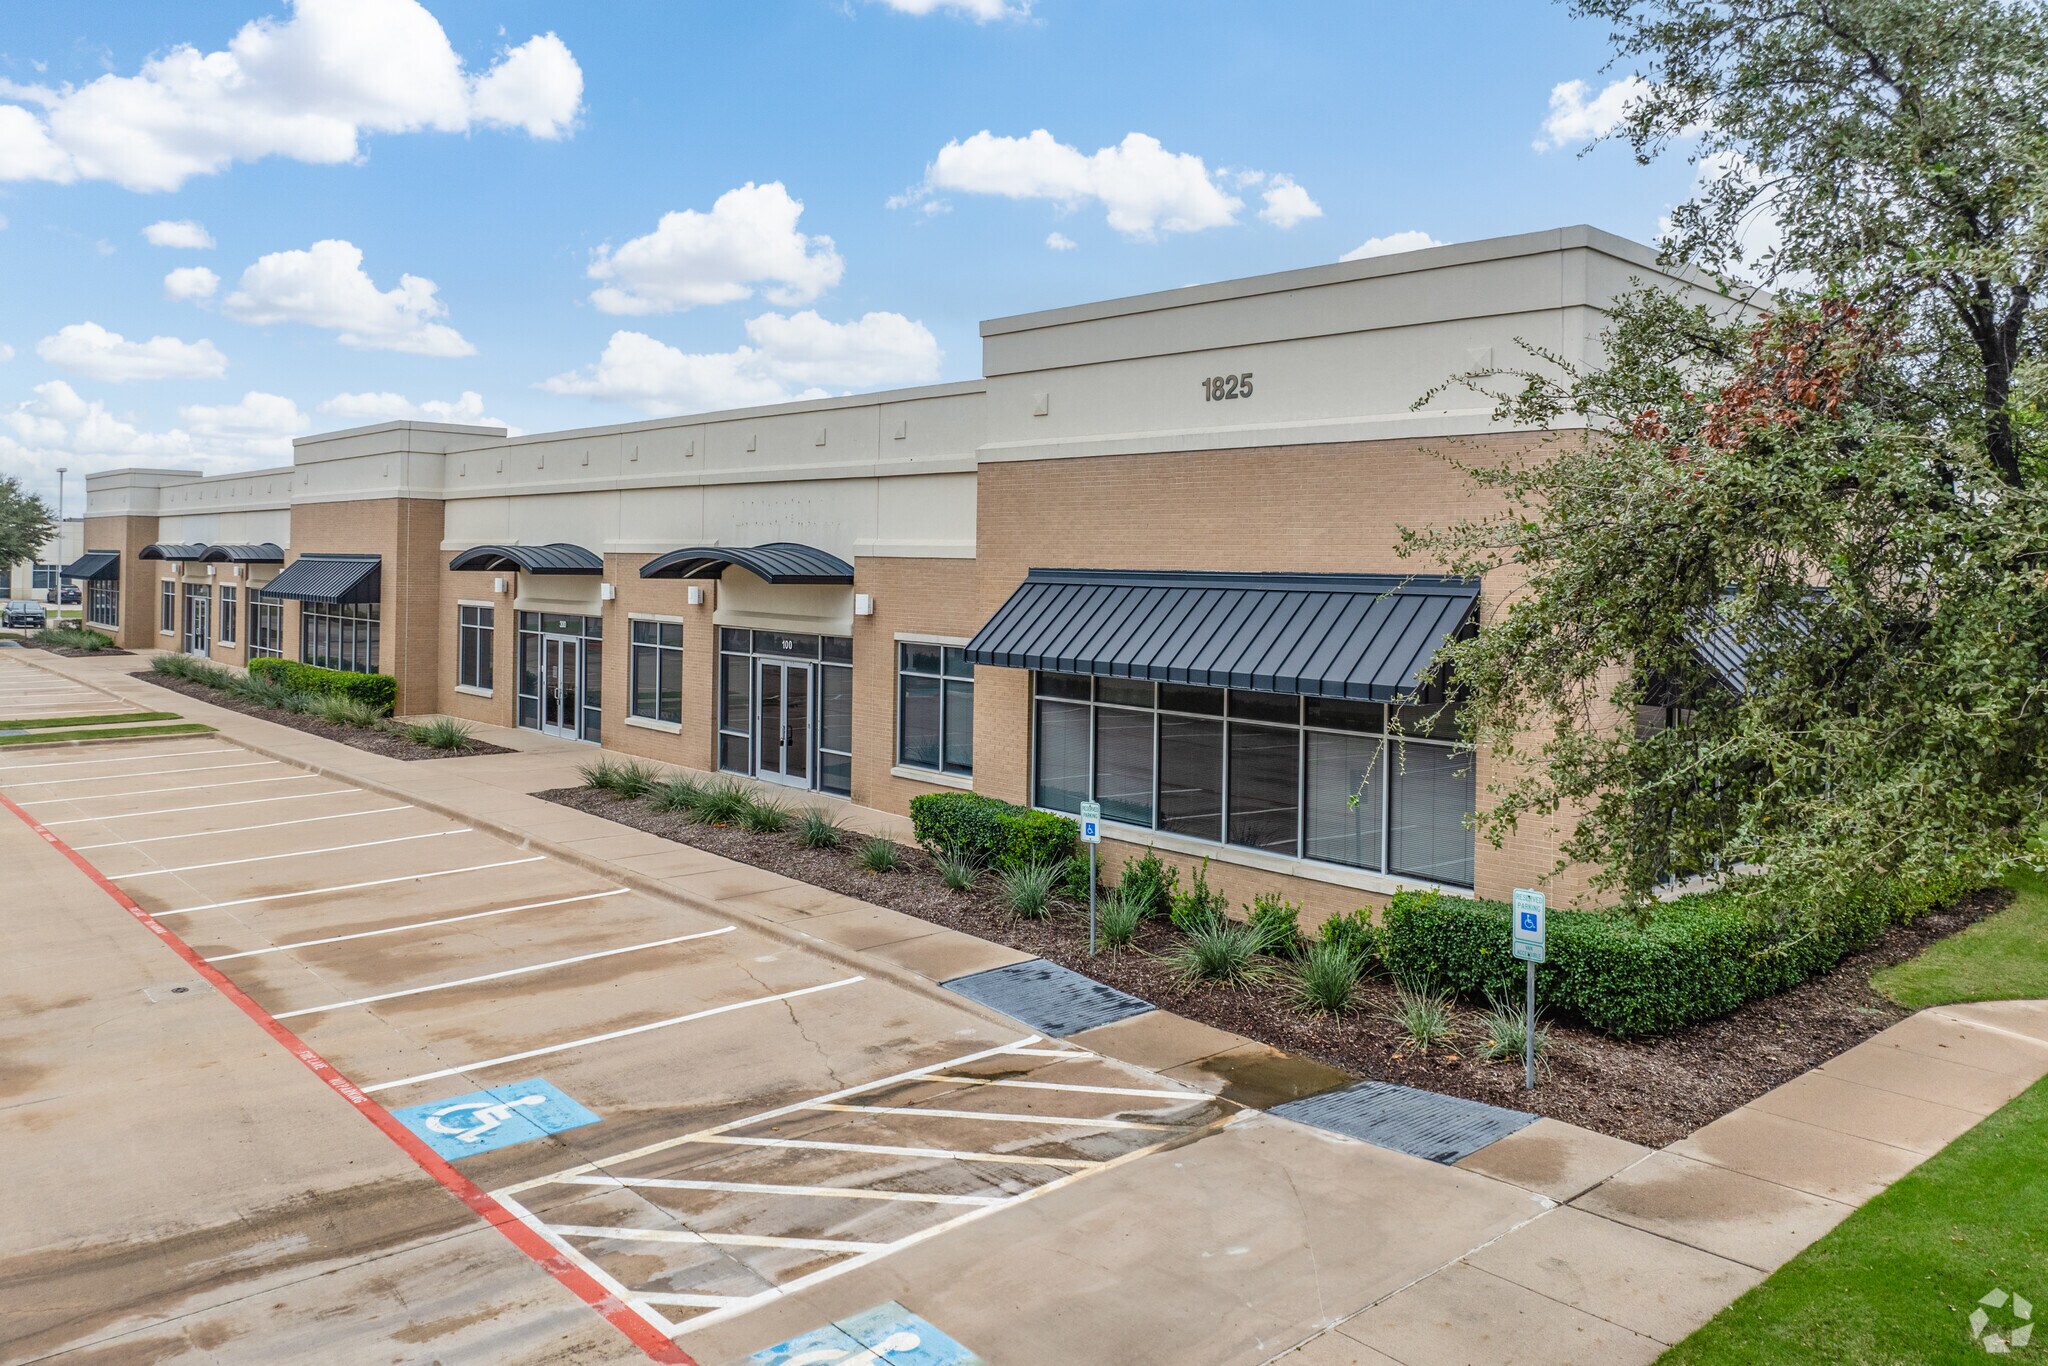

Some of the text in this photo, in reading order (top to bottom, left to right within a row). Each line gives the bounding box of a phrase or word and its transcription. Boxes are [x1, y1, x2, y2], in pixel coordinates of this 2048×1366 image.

[1202, 373, 1253, 401] 1825
[782, 640, 793, 650] 100
[1515, 893, 1543, 904] RESERVED
[1517, 902, 1541, 912] PARKING
[335, 1085, 368, 1104] PARKING
